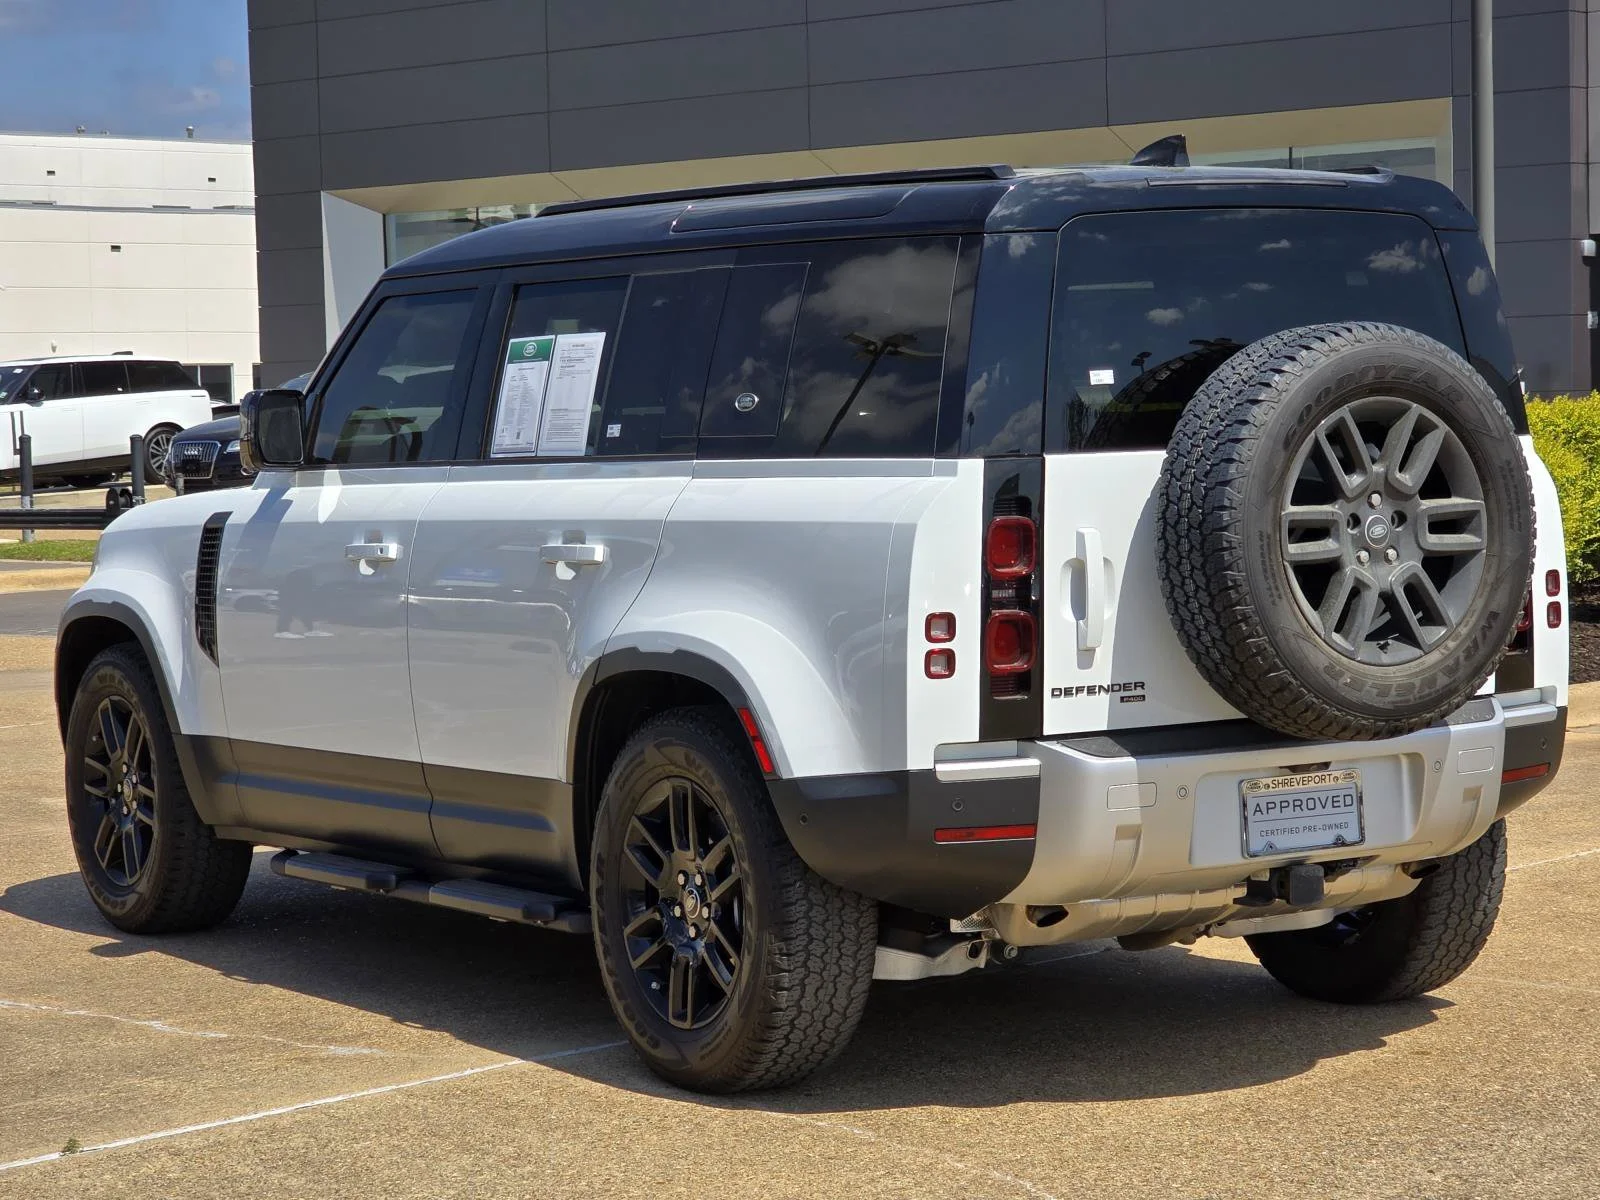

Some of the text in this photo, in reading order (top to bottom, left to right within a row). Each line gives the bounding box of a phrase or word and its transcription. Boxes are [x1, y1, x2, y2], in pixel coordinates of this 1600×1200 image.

[1321, 609, 1501, 696] WRANGLER
[1051, 682, 1145, 698] DEFENDER
[1271, 773, 1332, 789] SHREVEPORT
[1252, 793, 1353, 816] APPROVED
[1260, 821, 1349, 838] CERTIFIED PRE-OWNED
